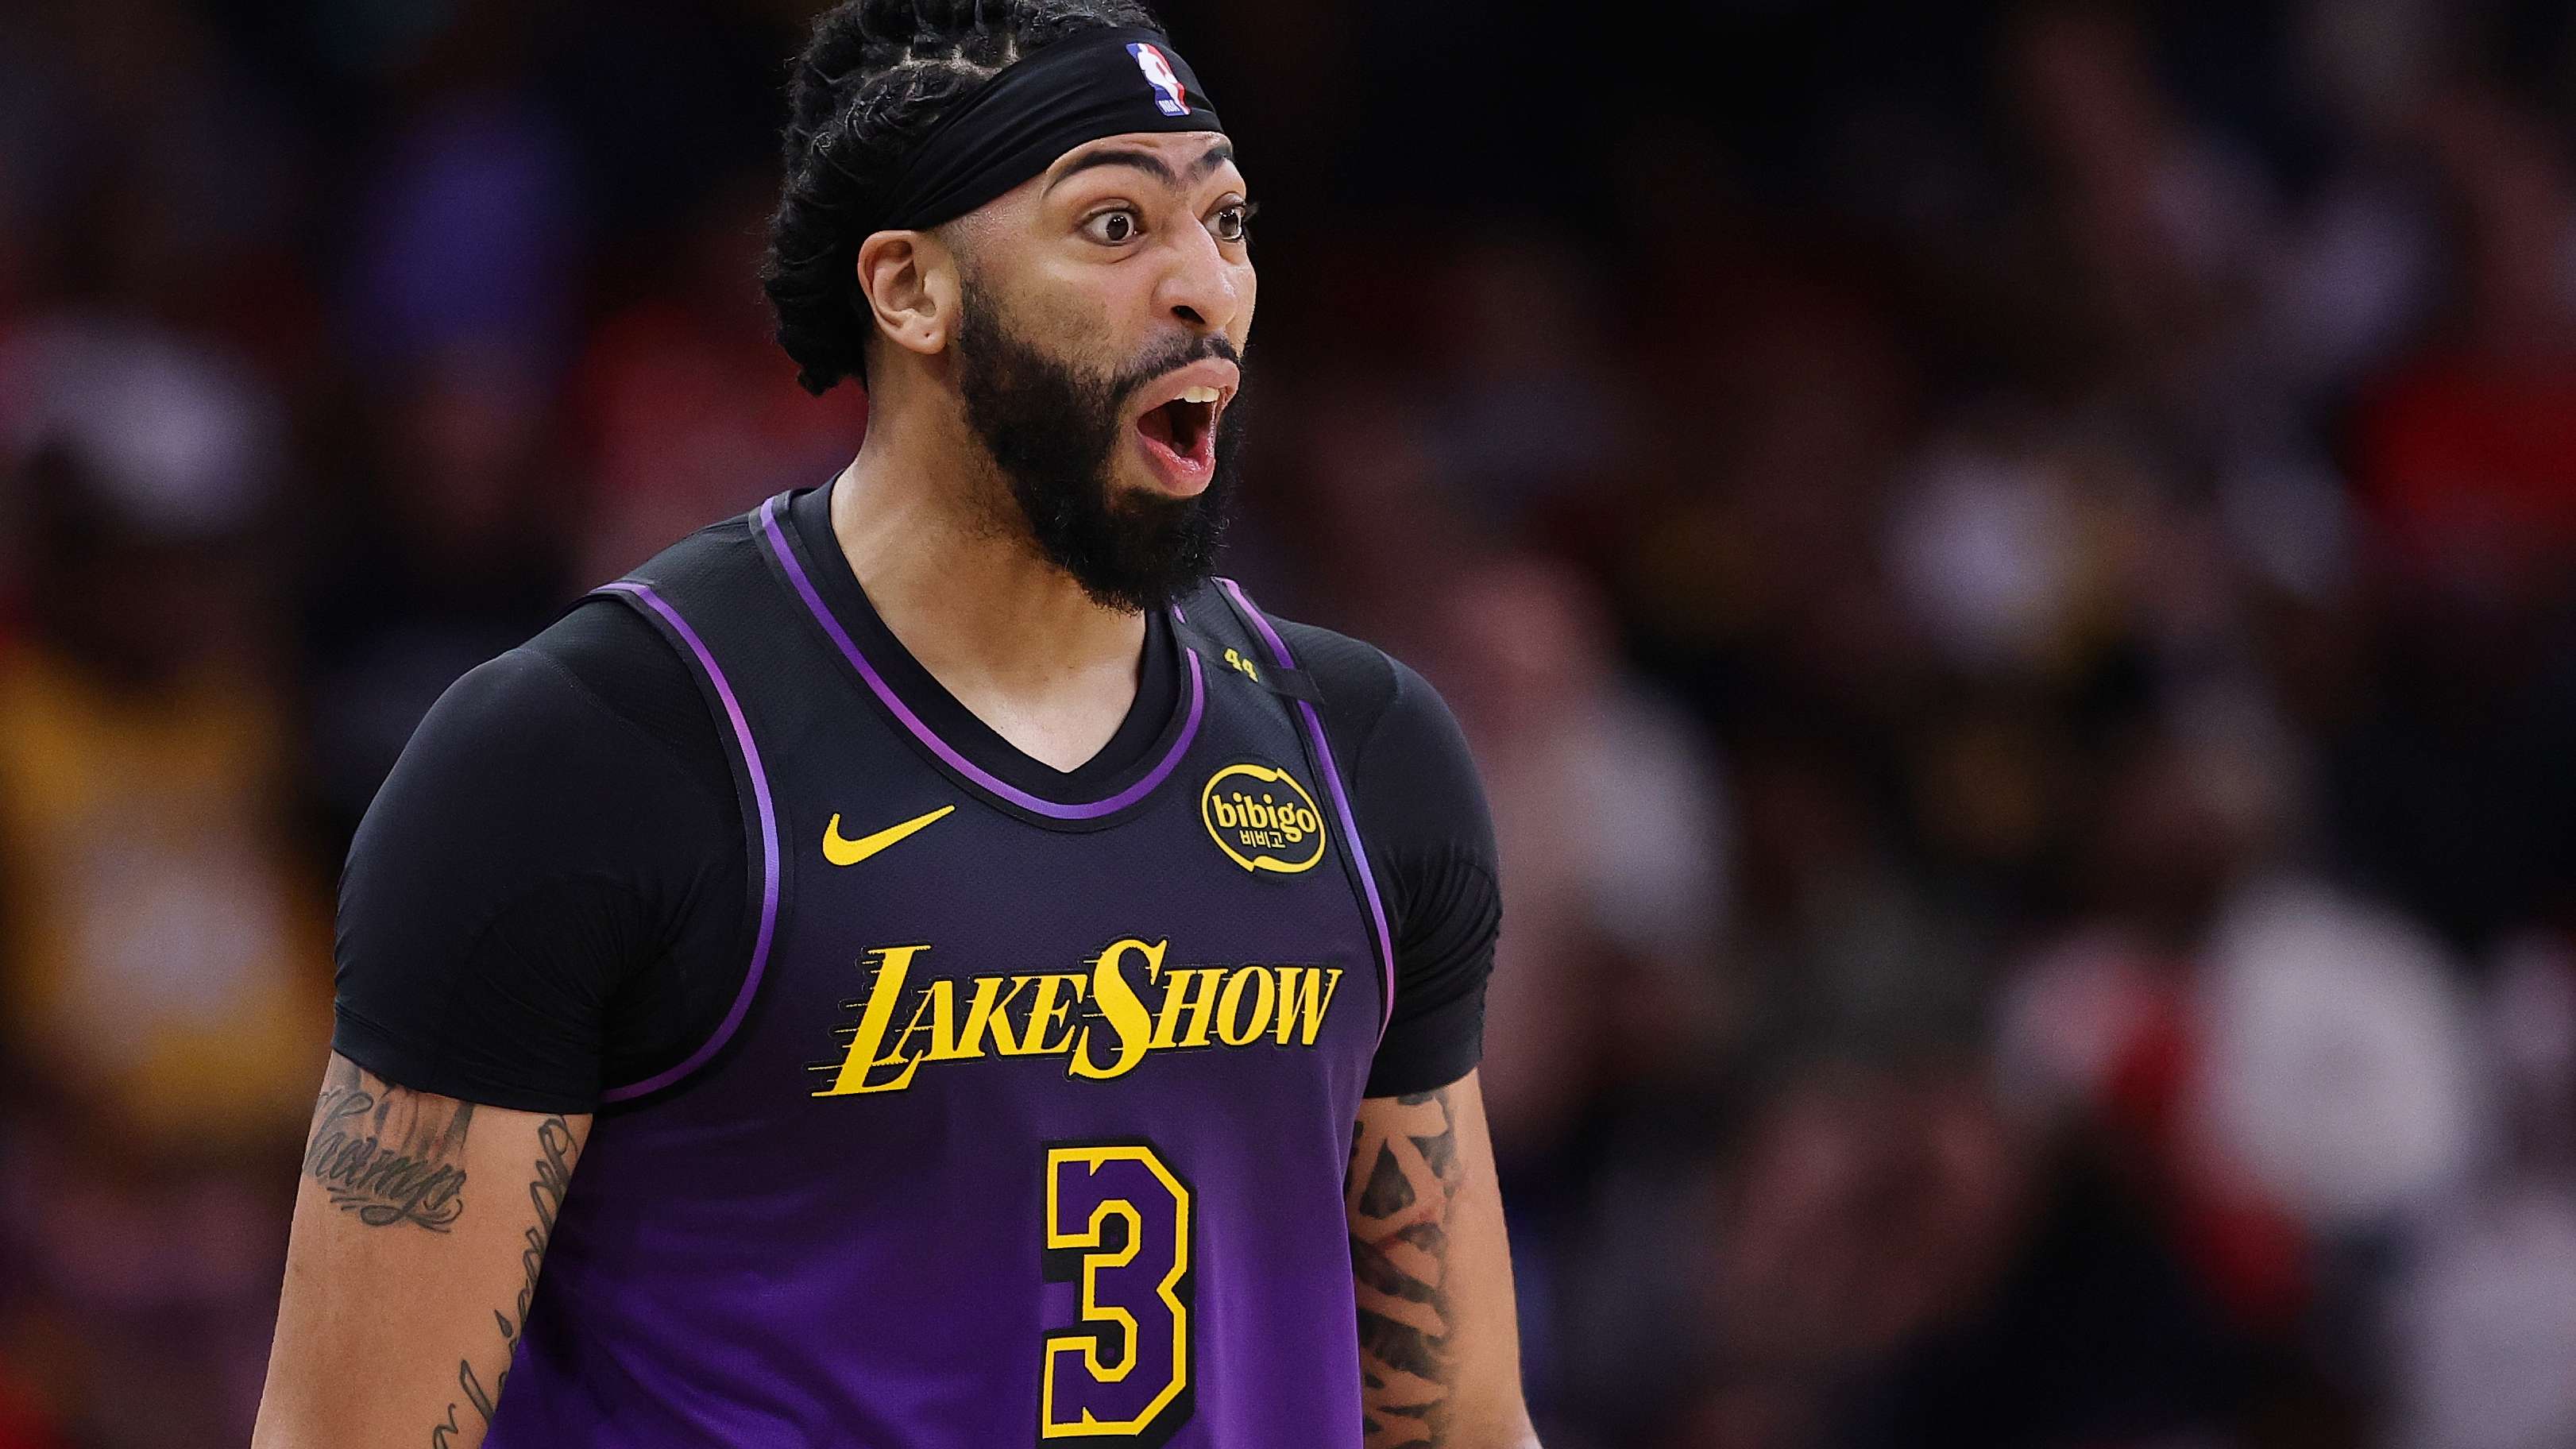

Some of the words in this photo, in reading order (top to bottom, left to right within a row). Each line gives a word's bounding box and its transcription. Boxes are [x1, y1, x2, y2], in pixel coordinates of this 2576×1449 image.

[1211, 792, 1317, 843] bibigo
[1239, 829, 1287, 848] 비비고
[1041, 1145, 1189, 1439] 3
